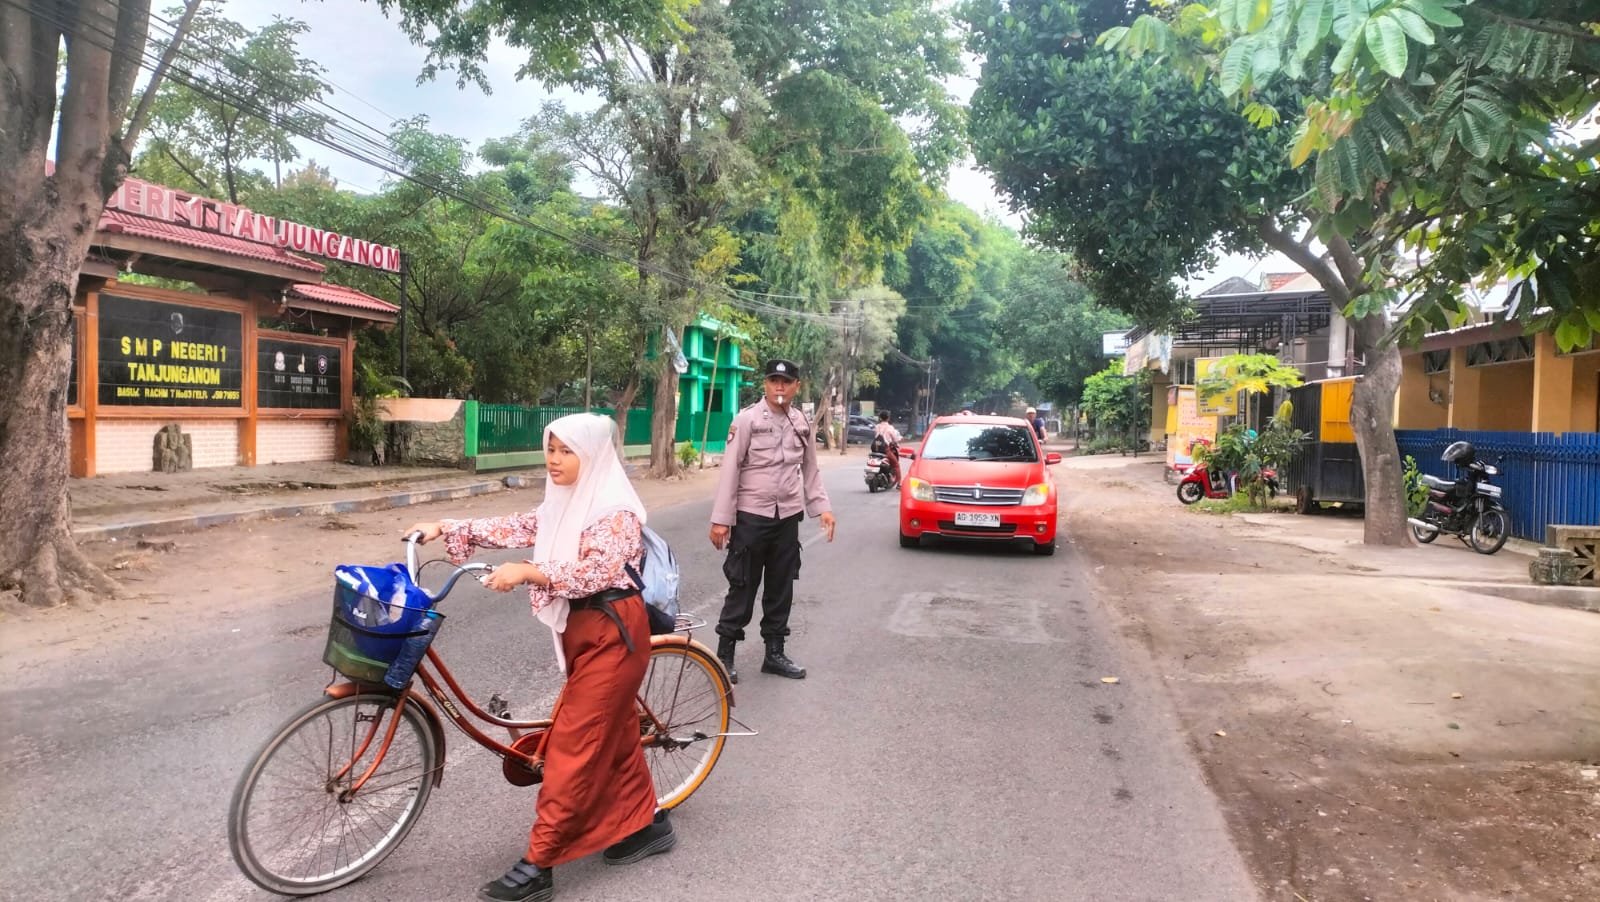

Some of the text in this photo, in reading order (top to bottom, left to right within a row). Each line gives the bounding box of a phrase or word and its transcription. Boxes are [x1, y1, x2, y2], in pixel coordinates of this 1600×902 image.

[186, 196, 203, 228] 1
[215, 203, 400, 272] TANJUNGANOM
[171, 341, 218, 362] NEGERI
[128, 362, 220, 384] TANJUNGANOM
